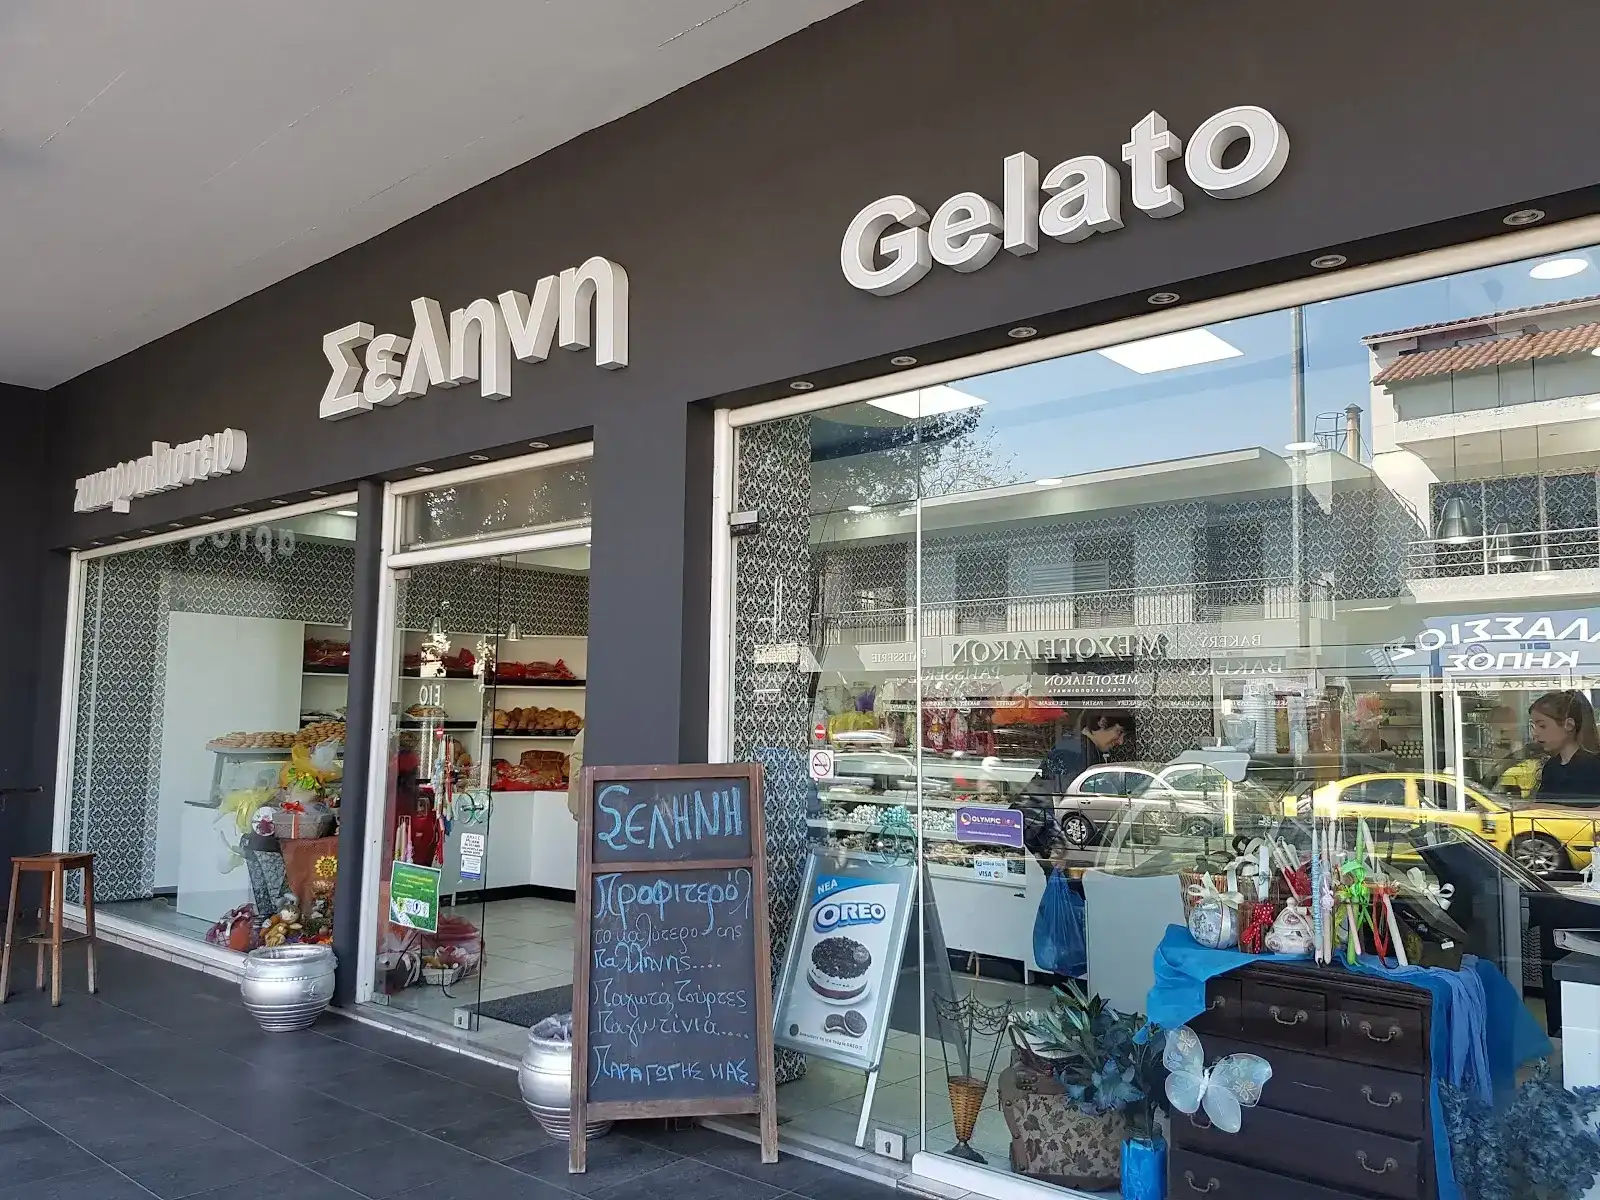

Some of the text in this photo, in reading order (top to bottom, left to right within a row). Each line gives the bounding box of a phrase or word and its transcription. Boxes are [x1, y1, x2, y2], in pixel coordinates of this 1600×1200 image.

[840, 105, 1291, 297] Gelato
[319, 255, 629, 421] Σεληνη
[971, 815, 1001, 825] OLYMPIC
[978, 870, 992, 878] VISA
[817, 878, 838, 895] ΝΕΑ
[814, 902, 886, 932] OREO
